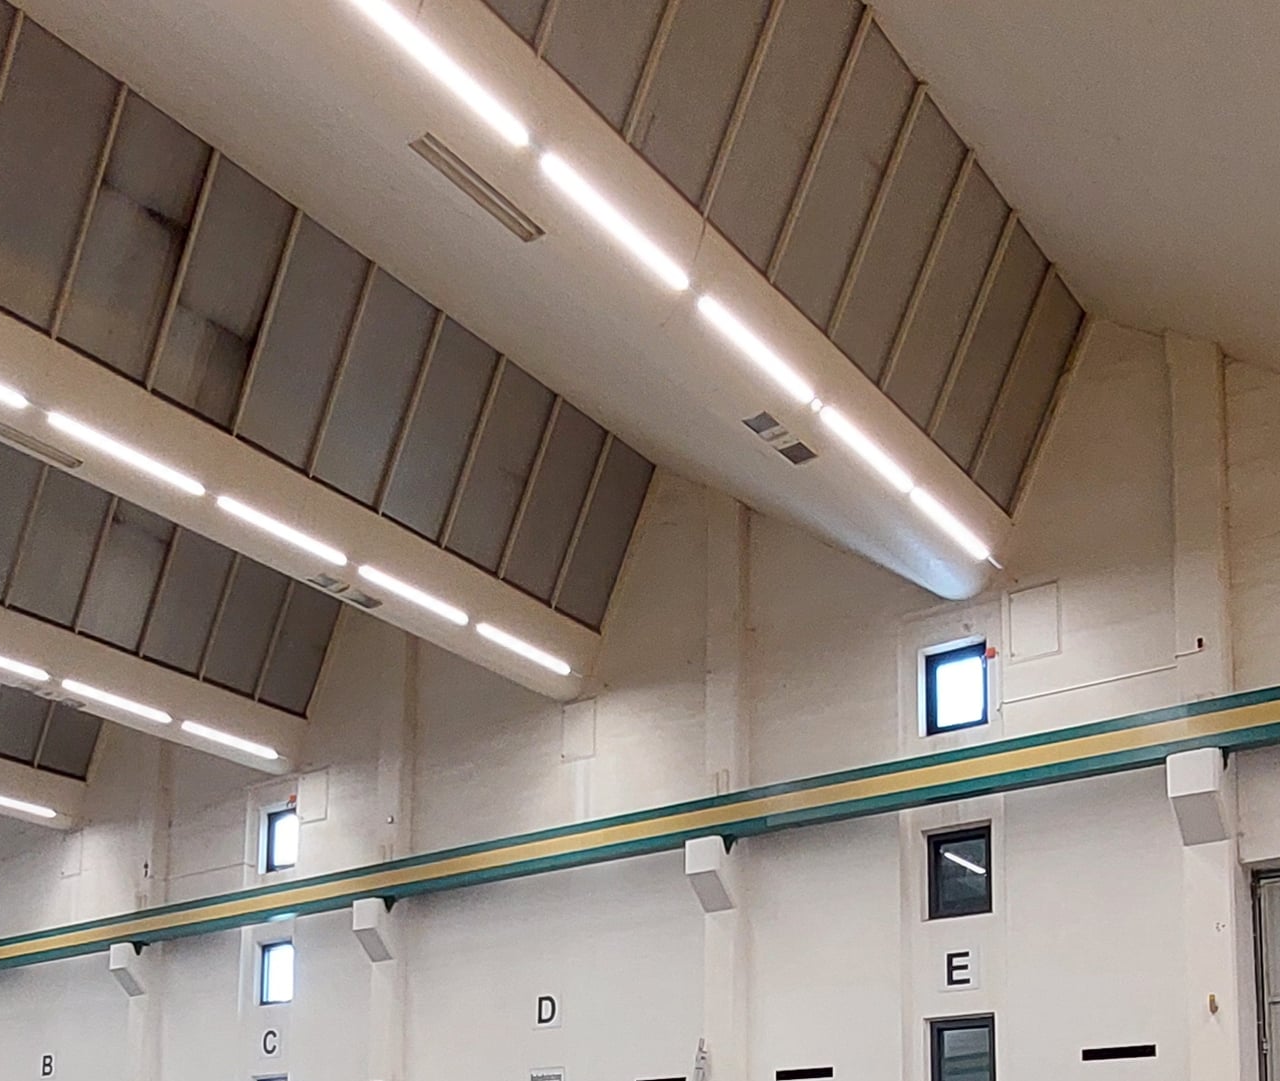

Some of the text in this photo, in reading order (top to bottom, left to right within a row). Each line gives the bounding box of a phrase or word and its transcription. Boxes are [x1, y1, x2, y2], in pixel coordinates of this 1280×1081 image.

[946, 951, 971, 986] E
[537, 995, 557, 1024] D
[262, 1030, 279, 1056] C
[41, 1054, 54, 1077] B
